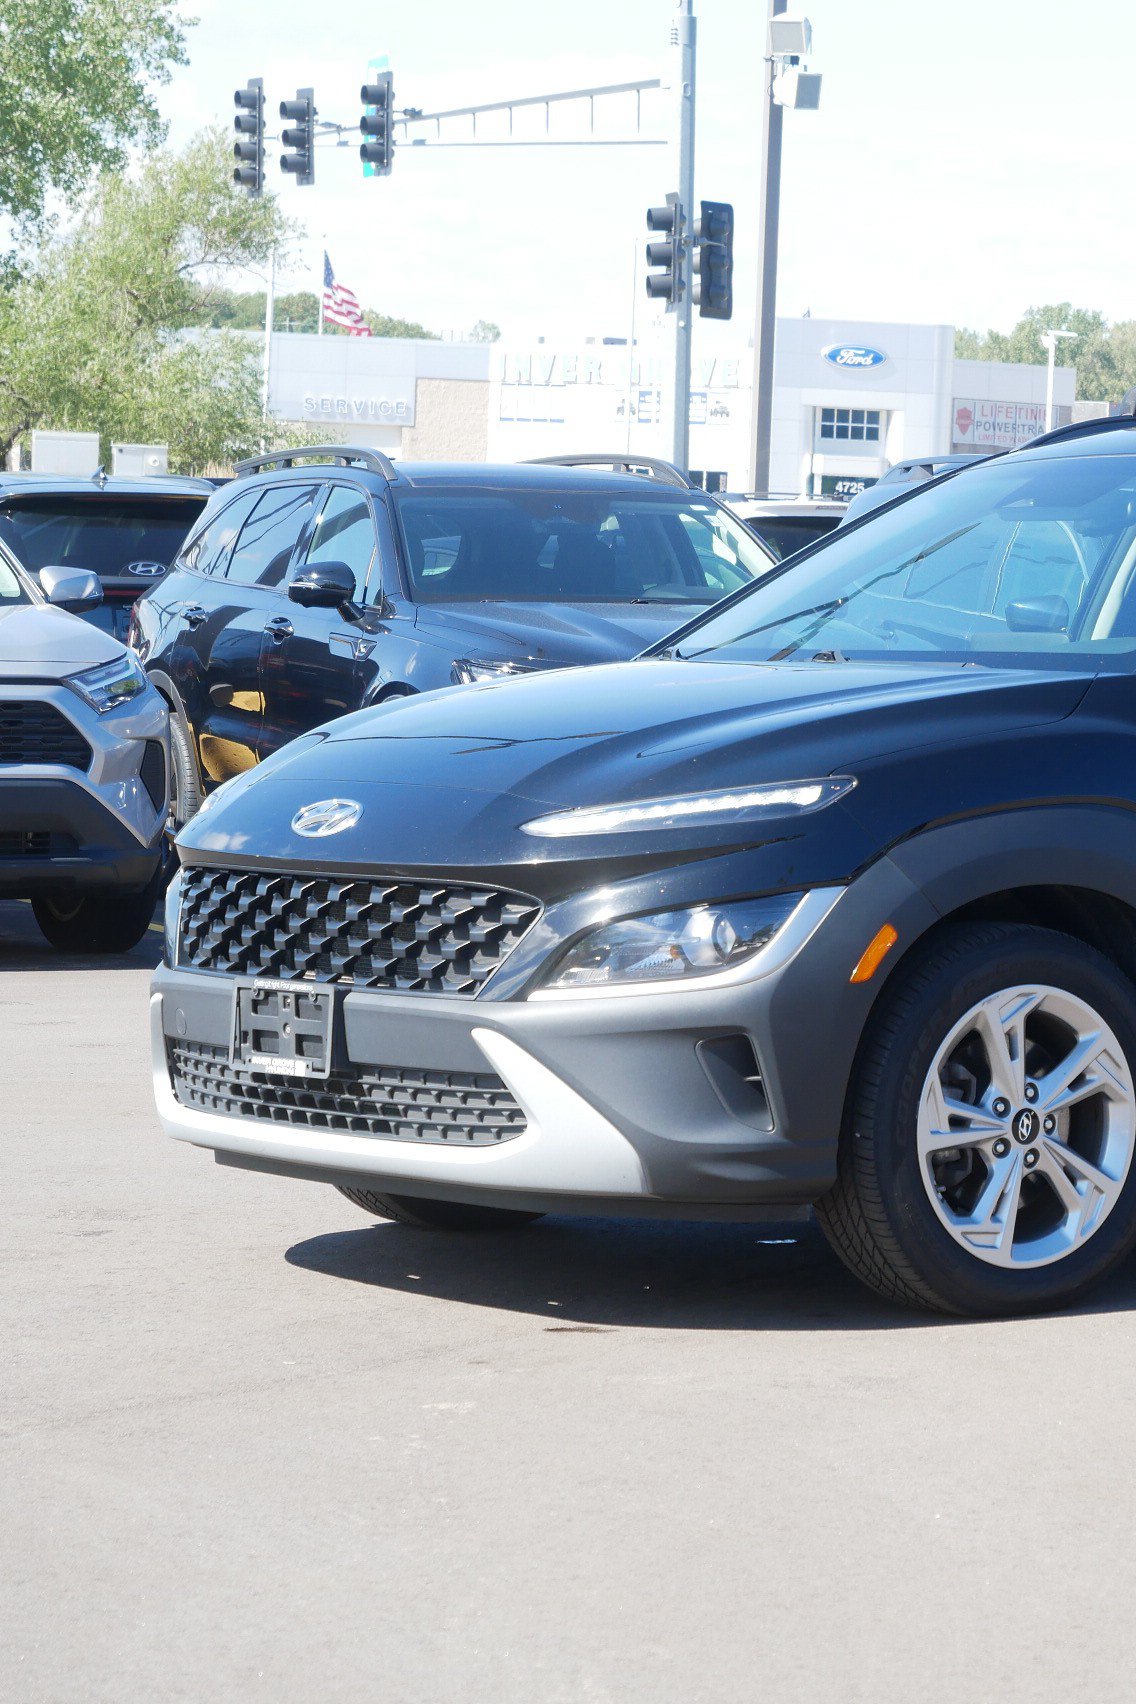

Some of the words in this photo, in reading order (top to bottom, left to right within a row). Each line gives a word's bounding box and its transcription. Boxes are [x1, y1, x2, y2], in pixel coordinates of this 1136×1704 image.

[836, 349, 874, 366] Ford
[304, 396, 407, 417] SERVICE
[976, 420, 1047, 436] POWERTRA
[835, 481, 865, 494] 4725
